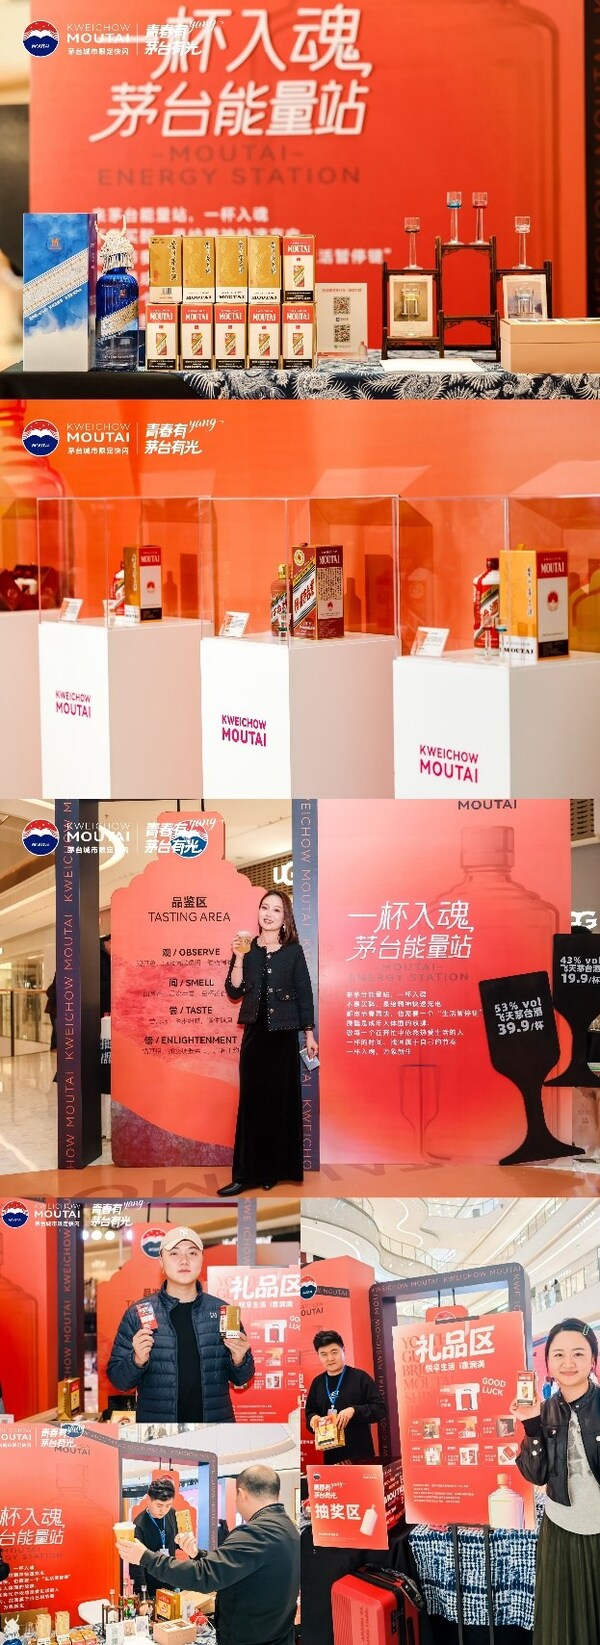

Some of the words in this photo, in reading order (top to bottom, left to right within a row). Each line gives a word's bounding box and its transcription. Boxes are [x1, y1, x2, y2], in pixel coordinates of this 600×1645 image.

[88, 79, 370, 143] 茅台能量站
[98, 168, 217, 186] ENERGY
[231, 167, 360, 185] STATION
[540, 561, 565, 574] MOUTAI
[55, 690, 91, 703] KWEICHOW
[56, 701, 91, 718] MOUTAI
[221, 714, 267, 730] KWEICHOW
[221, 727, 267, 747] MOUTAI
[419, 744, 479, 764] KWEICHOW
[419, 758, 479, 784] MOUTAI
[457, 799, 518, 810] MOUTAI
[171, 896, 208, 909] 品鉴区
[301, 869, 312, 926] MOUTAI
[147, 911, 197, 922] TASTING
[199, 911, 231, 922] AREA
[347, 899, 475, 934] 一杯入魂
[64, 913, 73, 970] MOUTAI
[345, 934, 474, 962] 茅台能量站
[162, 948, 171, 957] 观
[178, 948, 220, 956] OBSERVE
[560, 956, 582, 964] 43%
[185, 979, 215, 987] SMELL
[410, 972, 469, 982] STATION
[185, 1006, 213, 1014] TASTE
[494, 1001, 519, 1013] 53%
[521, 996, 542, 1009] vol
[64, 976, 74, 1060] KWEICHOW
[495, 1006, 543, 1022] 飞天茅台酒
[497, 1019, 545, 1036] 39.9/杯
[161, 1036, 237, 1044] ENLIGHTENMENT
[65, 1071, 75, 1127] MOUTAI
[63, 1229, 72, 1293] KWEICHOW
[229, 1274, 301, 1300] 礼品区
[410, 1278, 438, 1287] MOUTAI
[443, 1271, 486, 1283] KWEICHOW
[63, 1300, 72, 1343] MOUTAI
[414, 1324, 495, 1364] 礼品区
[482, 1377, 507, 1388] GOOD
[482, 1386, 504, 1397] LUCK
[54, 1446, 91, 1456] MOUTAI
[314, 1502, 362, 1521] 抽奖区
[0, 1528, 65, 1546] 台能量站
